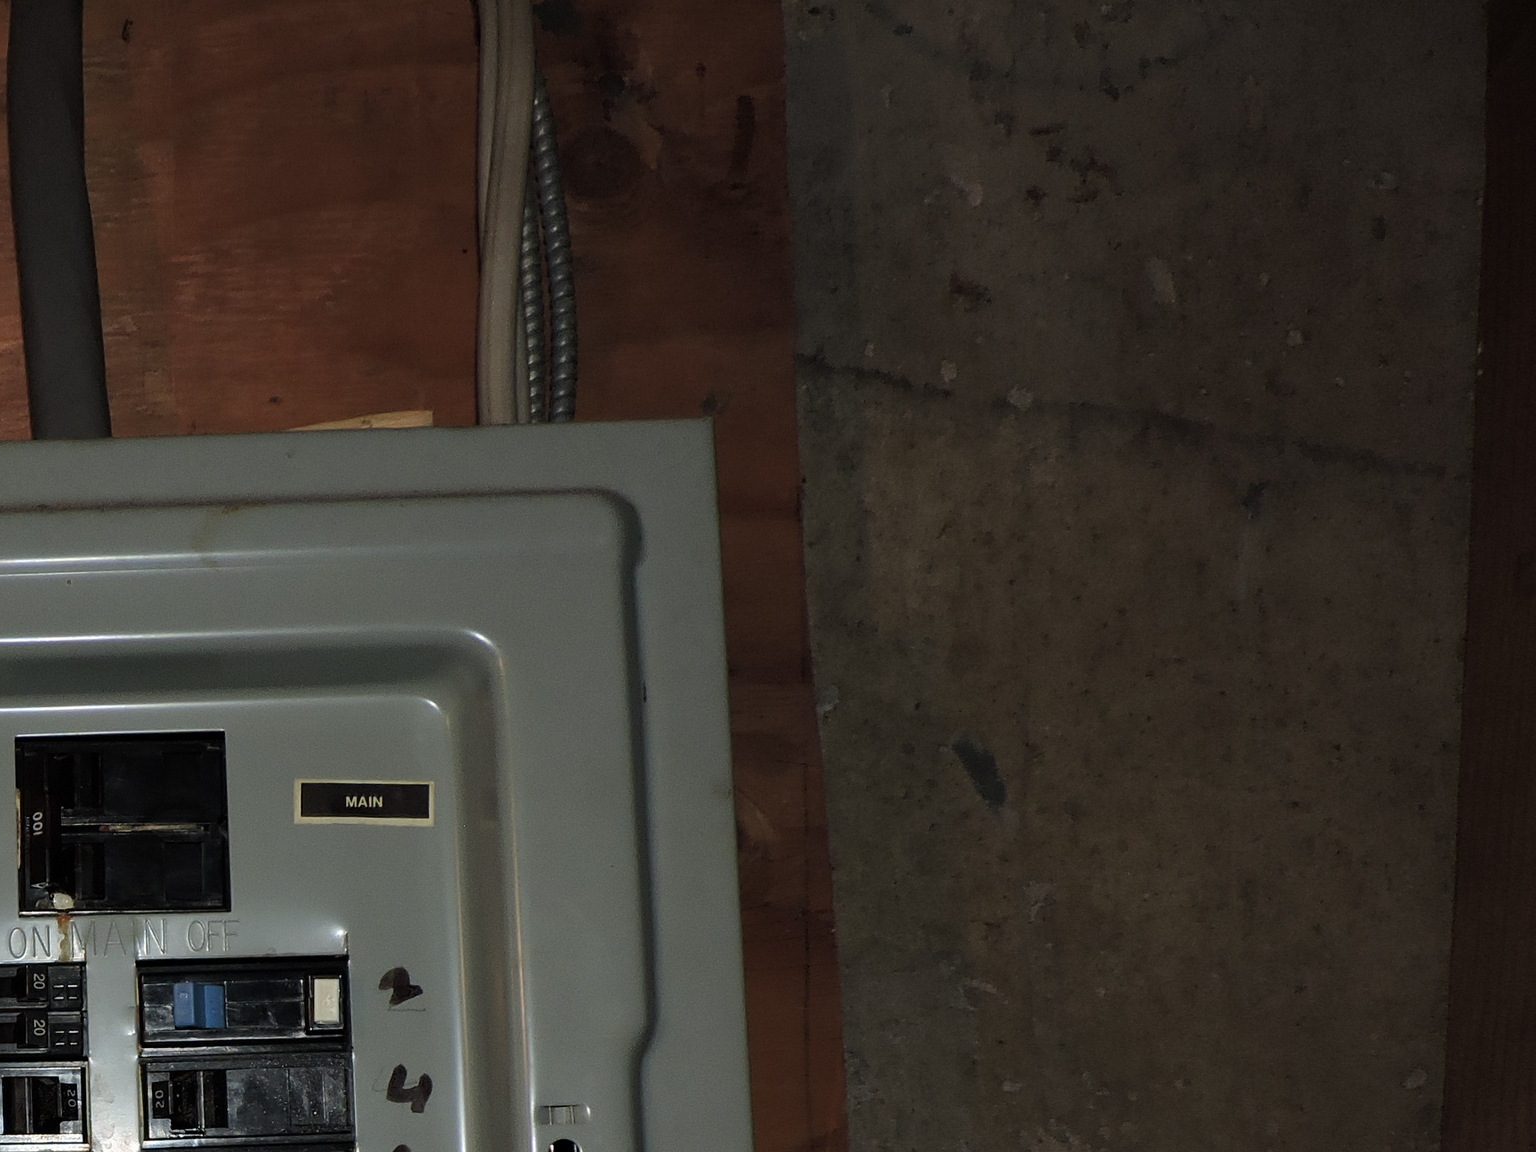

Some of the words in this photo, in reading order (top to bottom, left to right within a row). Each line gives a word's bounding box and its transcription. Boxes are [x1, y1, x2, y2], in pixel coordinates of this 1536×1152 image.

[345, 794, 383, 809] MAIN
[9, 925, 51, 959] ON
[70, 919, 167, 957] MAIN
[188, 920, 240, 951] OFF
[33, 973, 45, 989] 20
[33, 1019, 45, 1036] 20
[386, 1064, 432, 1113] 4
[67, 1089, 76, 1108] 20
[156, 1090, 164, 1108] 20
